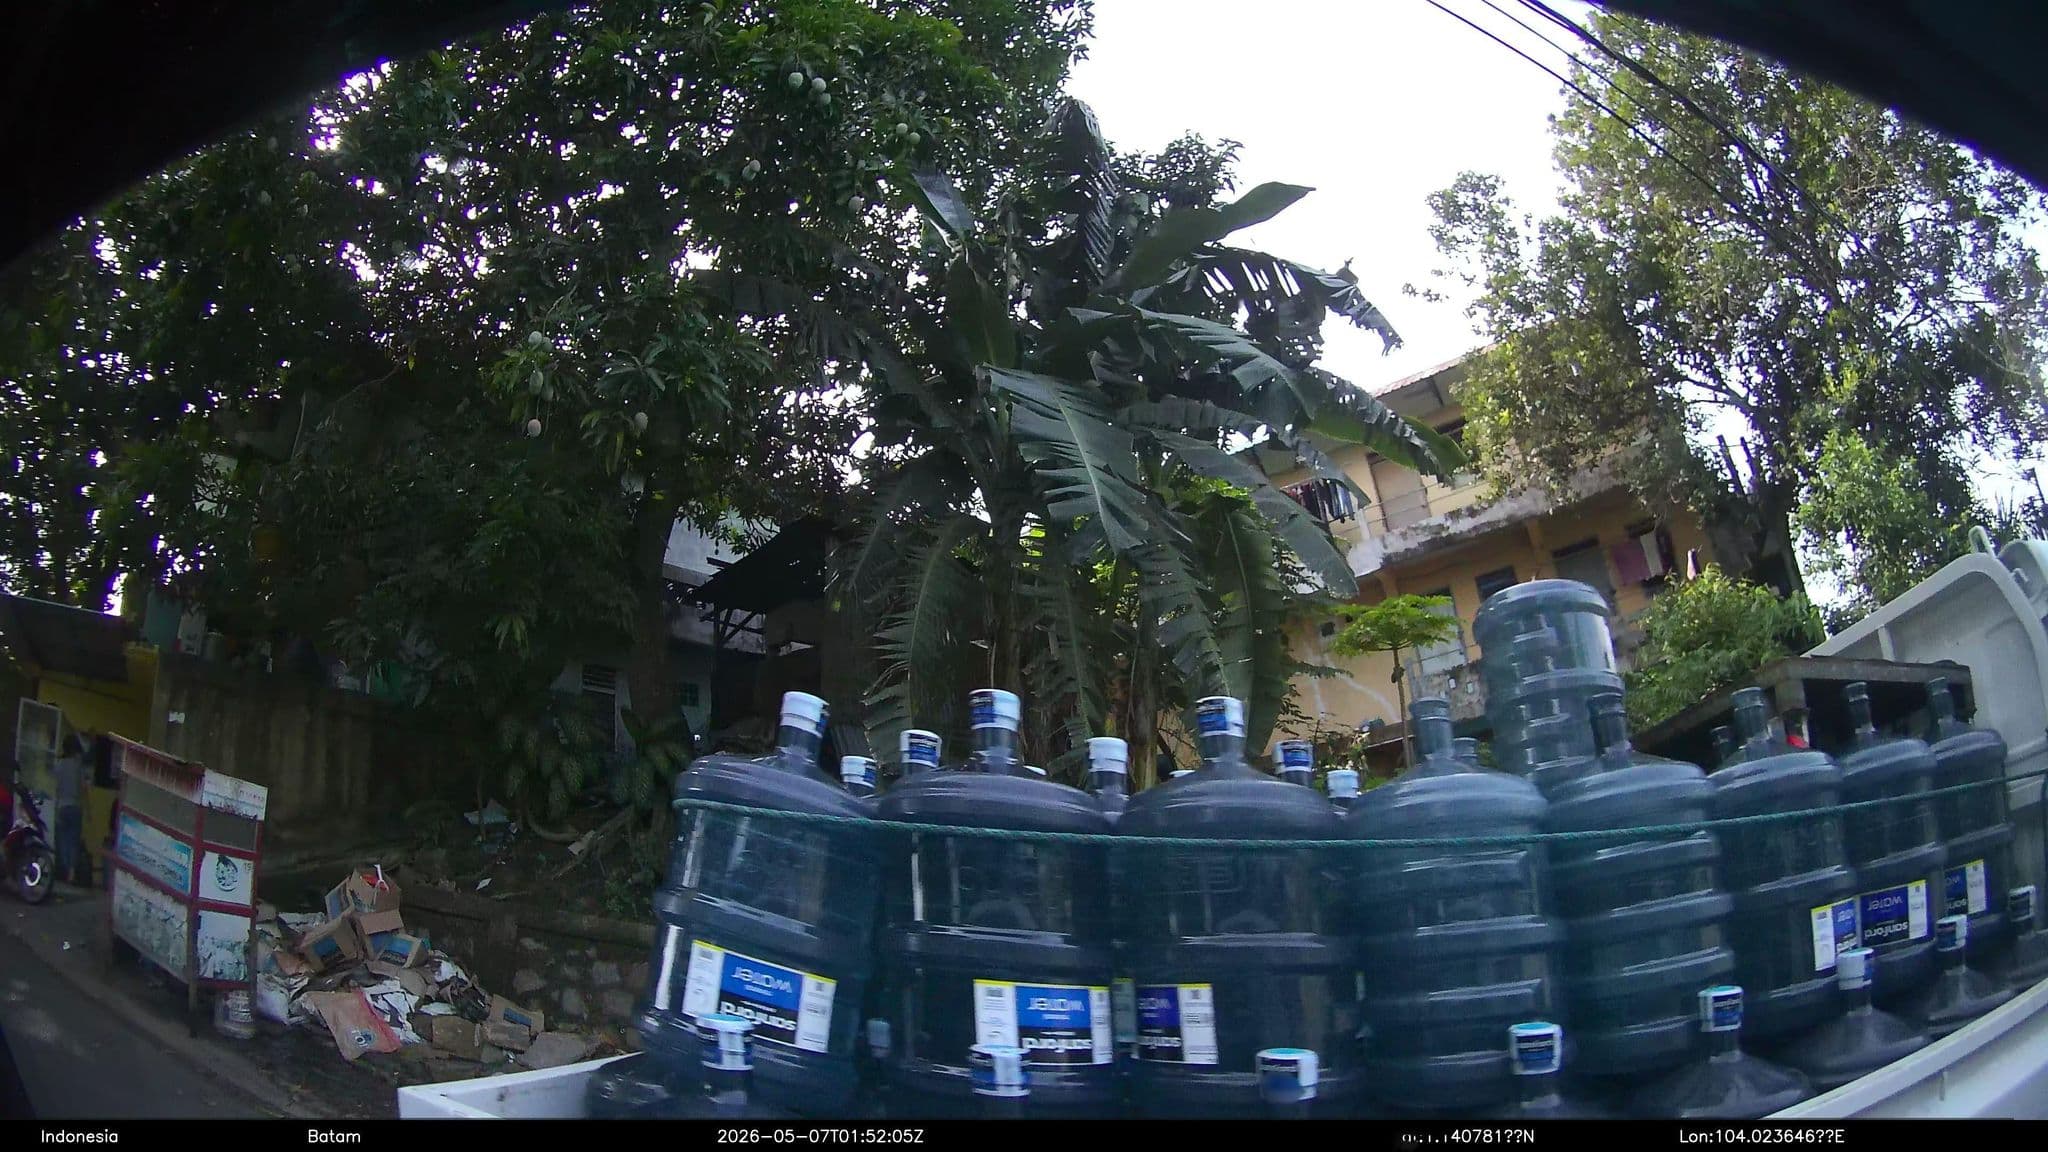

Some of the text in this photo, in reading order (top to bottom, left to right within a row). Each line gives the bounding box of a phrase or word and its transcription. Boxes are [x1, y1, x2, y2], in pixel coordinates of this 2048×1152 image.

[1868, 895, 1903, 911] water
[1864, 921, 1909, 942] sanford
[731, 966, 793, 993] water
